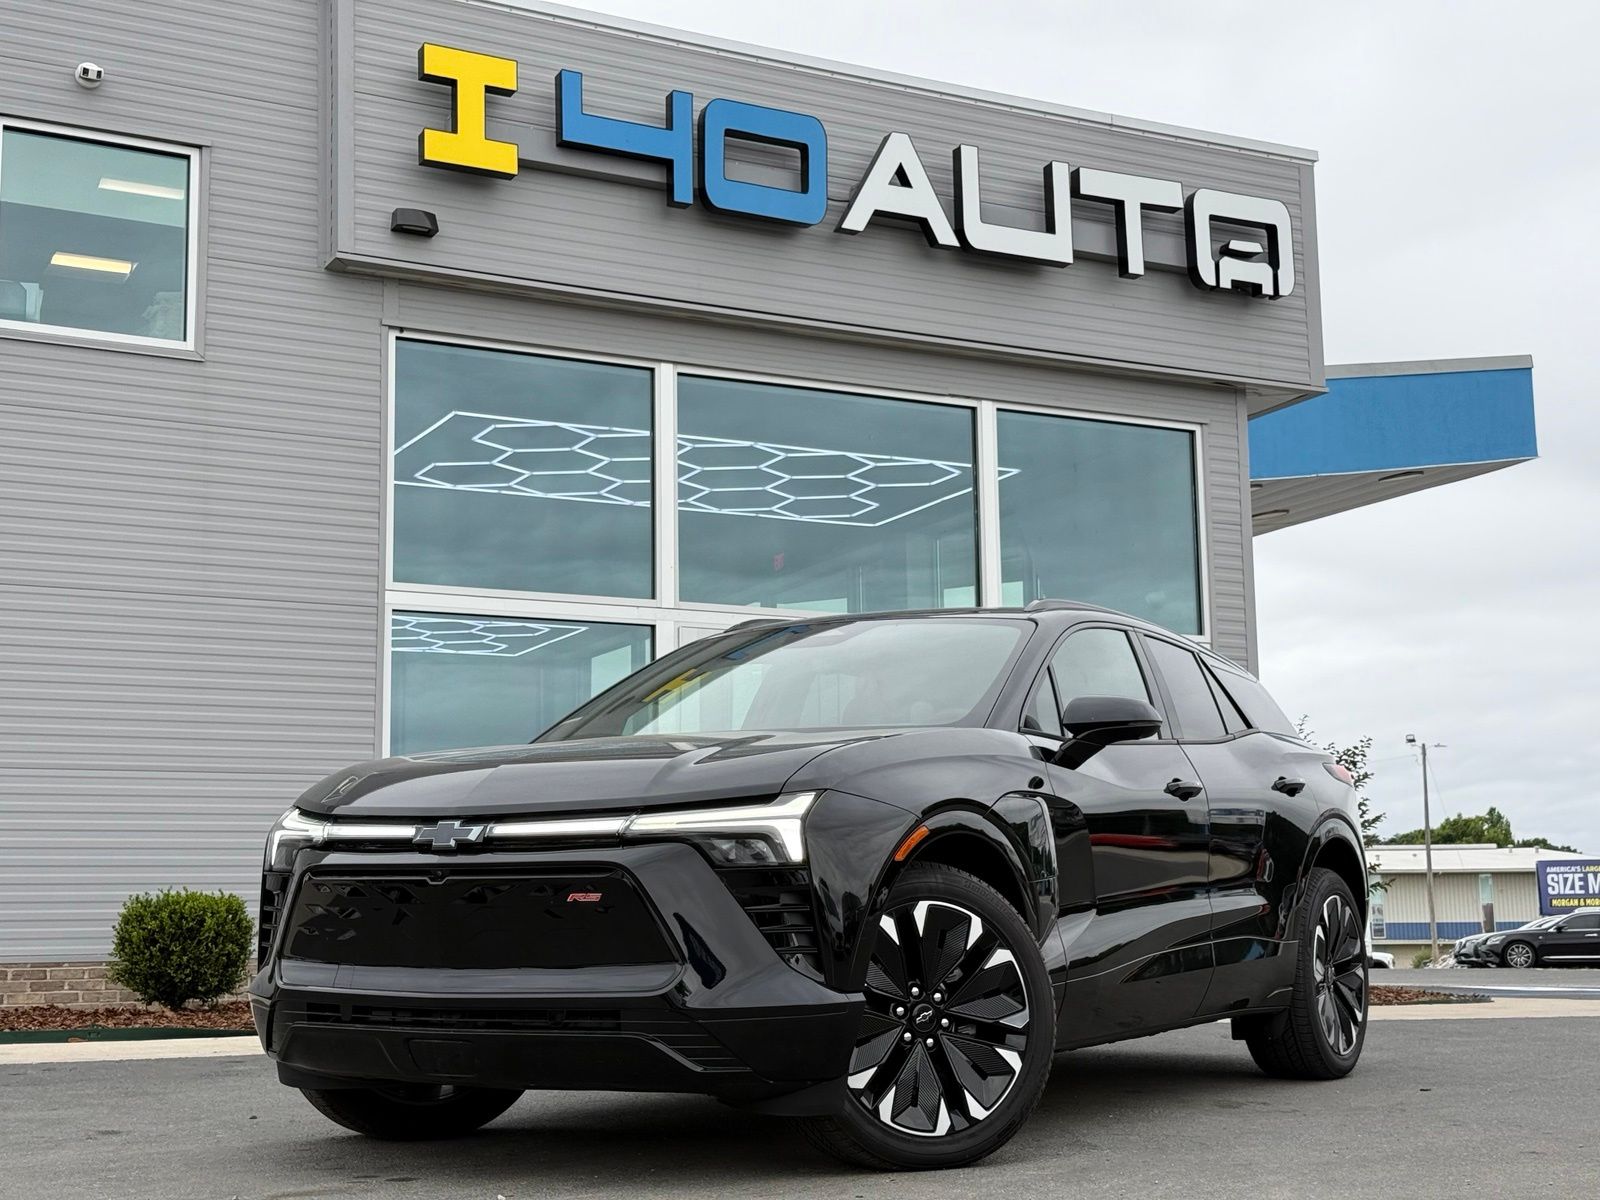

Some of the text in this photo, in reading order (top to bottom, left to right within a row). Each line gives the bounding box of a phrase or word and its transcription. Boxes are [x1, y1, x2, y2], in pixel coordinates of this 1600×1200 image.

[418, 42, 1297, 300] I 40 AUTO
[1546, 865, 1581, 873] AMERICA'S
[1546, 873, 1585, 895] SIZE
[567, 892, 602, 902] RS
[1551, 898, 1578, 907] MORGAN
[1579, 898, 1586, 907] &
